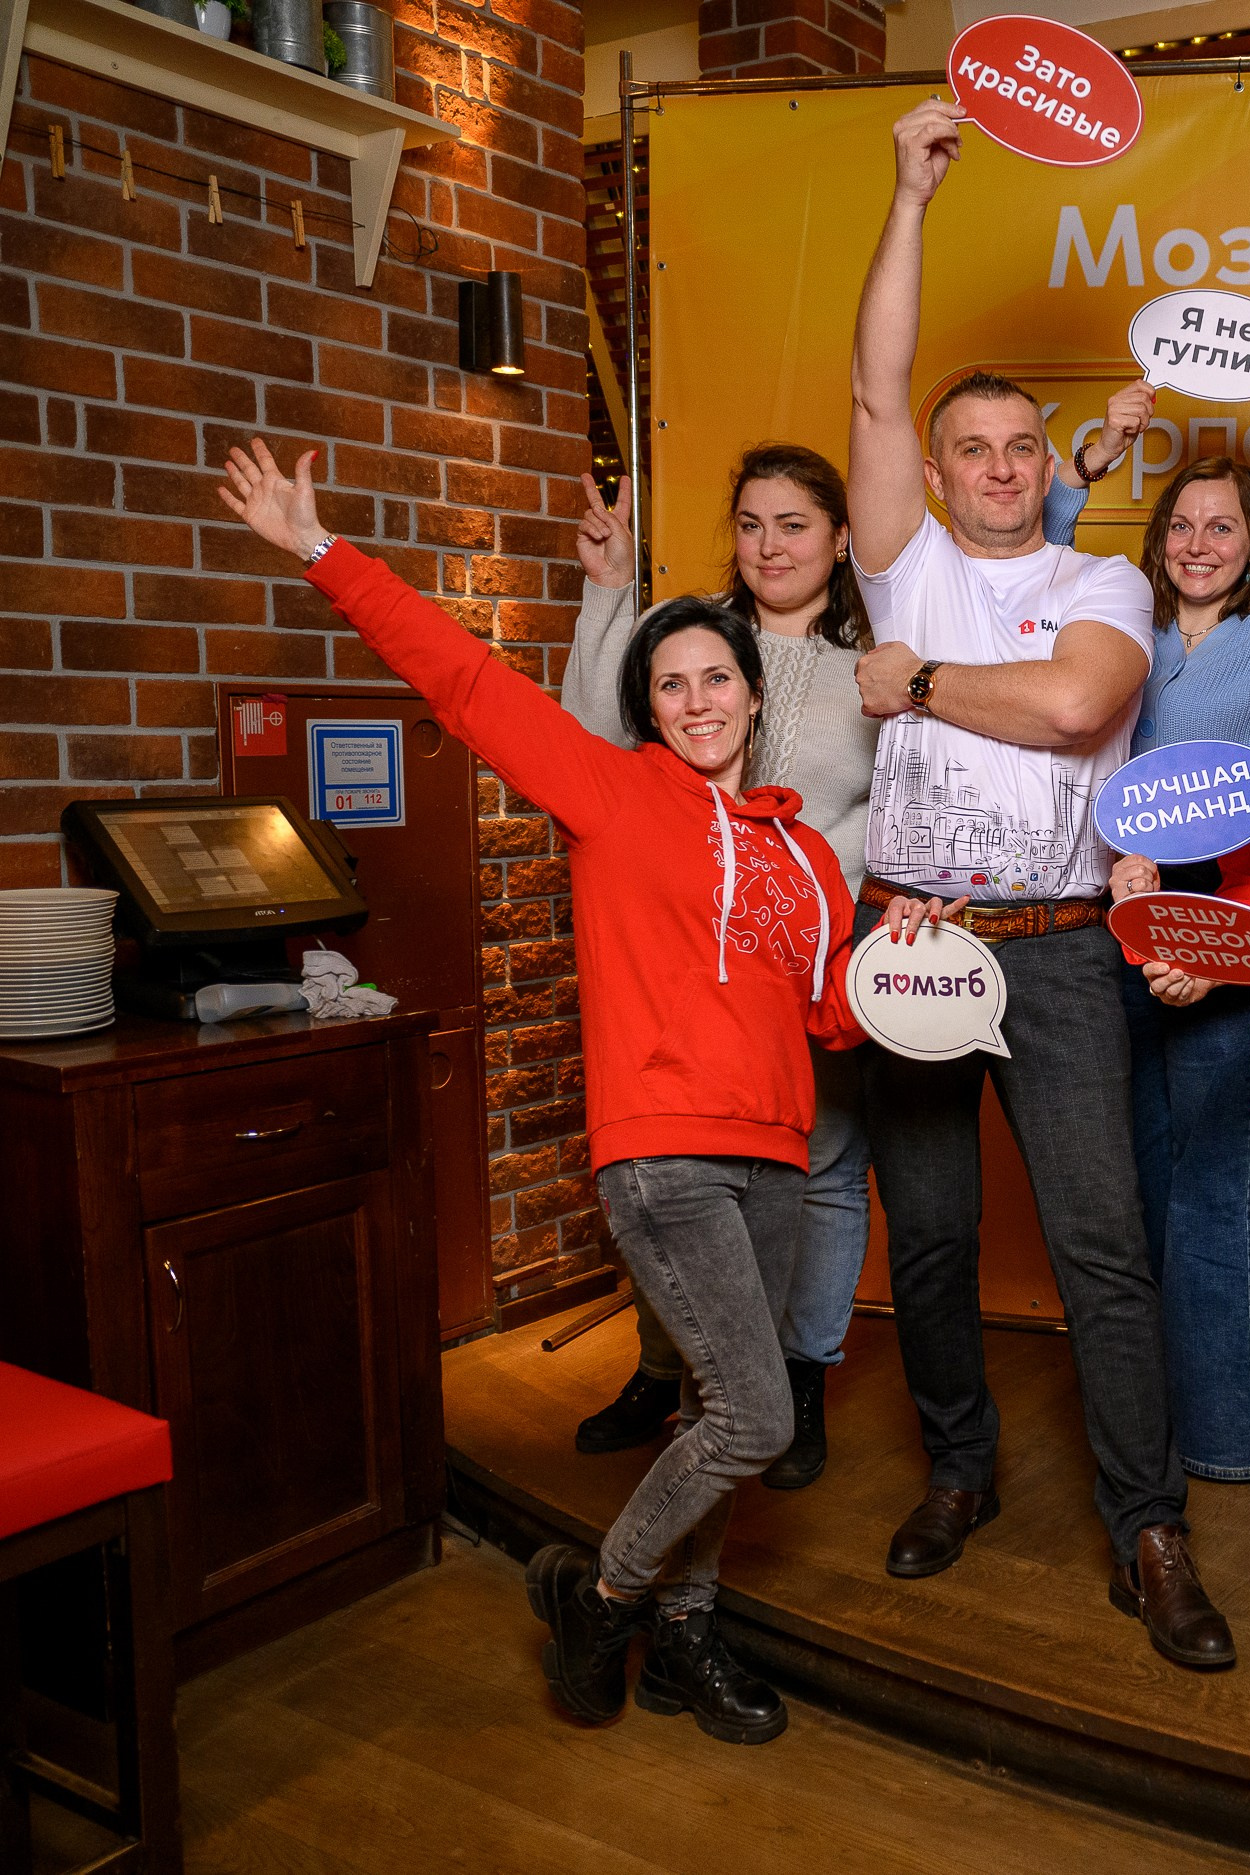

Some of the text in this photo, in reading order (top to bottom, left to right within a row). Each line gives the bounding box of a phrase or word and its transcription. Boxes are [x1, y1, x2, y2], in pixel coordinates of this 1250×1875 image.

[1014, 44, 1092, 99] Зато
[957, 55, 1121, 149] красивые
[1180, 307, 1205, 333] Я
[330, 741, 375, 749] Ответственный
[1121, 760, 1250, 808] ЛУЧШАЯ
[335, 793, 382, 810] 01 112
[1147, 904, 1238, 927] РЕШУ
